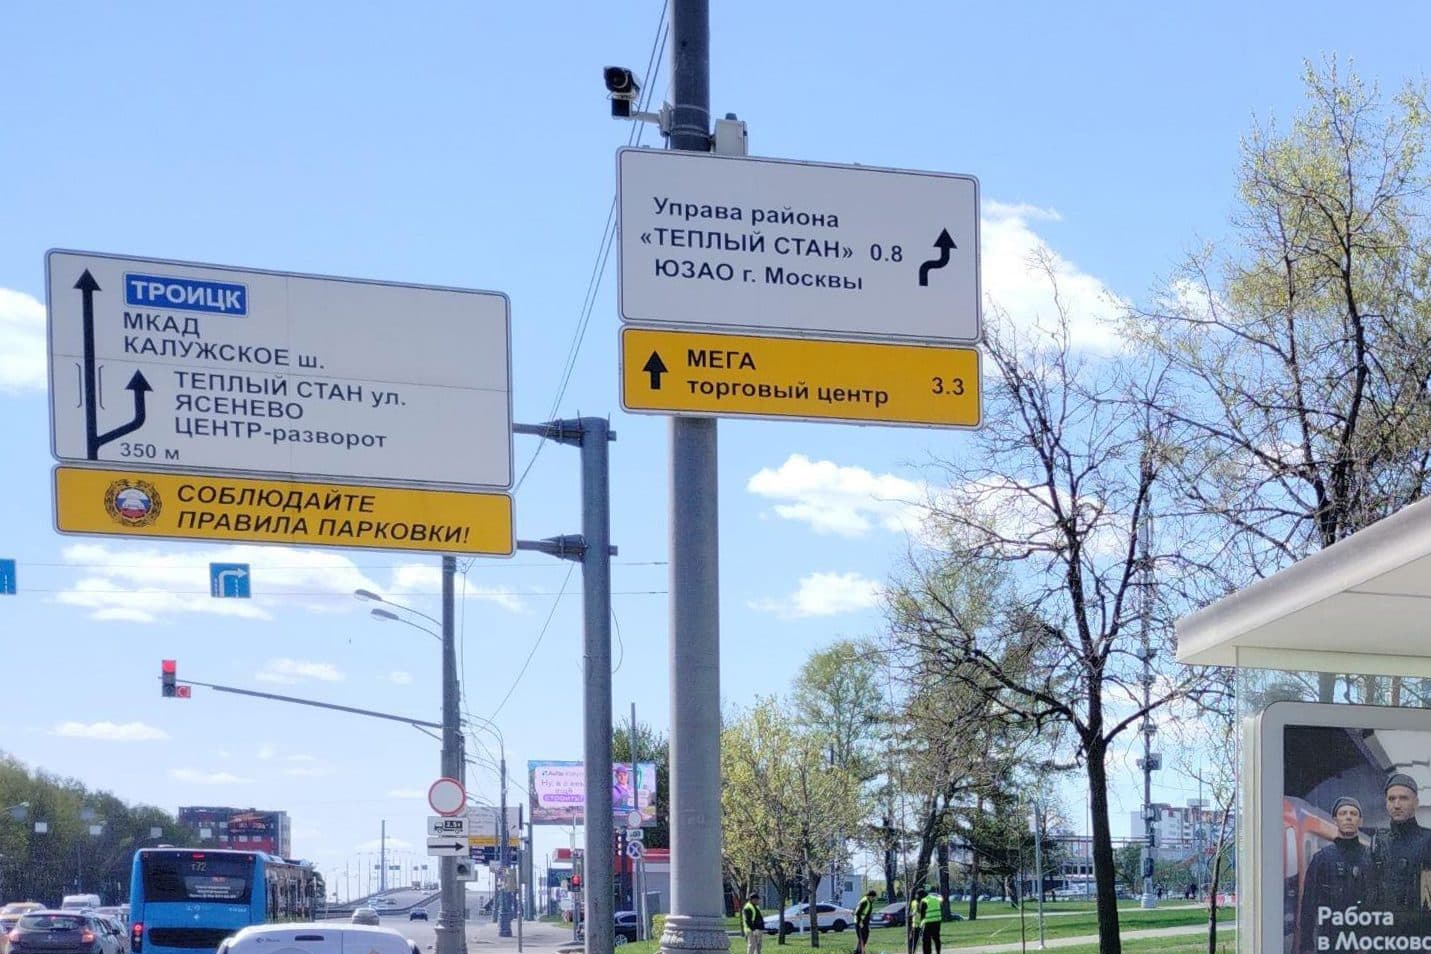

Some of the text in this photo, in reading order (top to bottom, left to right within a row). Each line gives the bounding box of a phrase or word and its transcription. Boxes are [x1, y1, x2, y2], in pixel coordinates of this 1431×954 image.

[653, 197, 839, 229] Управа района
[640, 227, 903, 262] «ТЕПЛЫЙ СТАН» 0.8
[655, 259, 862, 290] ЮЗАО г. Москвы
[131, 280, 243, 310] ТРОИЦК
[124, 312, 201, 339] МКАД
[124, 336, 325, 369] КАЛУЖСКОЕ ш.
[687, 349, 756, 370] МЕГА
[174, 370, 407, 408] ТЕПЛЫЙ СТАН ул.
[687, 377, 965, 408] торговый центр 3.3
[175, 395, 304, 420] ЯСЕНЕВО
[175, 417, 388, 448] ЦЕНТР-разворот
[120, 442, 180, 460] 350 м
[177, 484, 376, 514] СОБЛЮДАЙТЕ
[177, 512, 471, 544] ПРАВИЛА ПАРКОВКИ!
[1317, 905, 1394, 926] Работа
[1318, 936, 1330, 950] в
